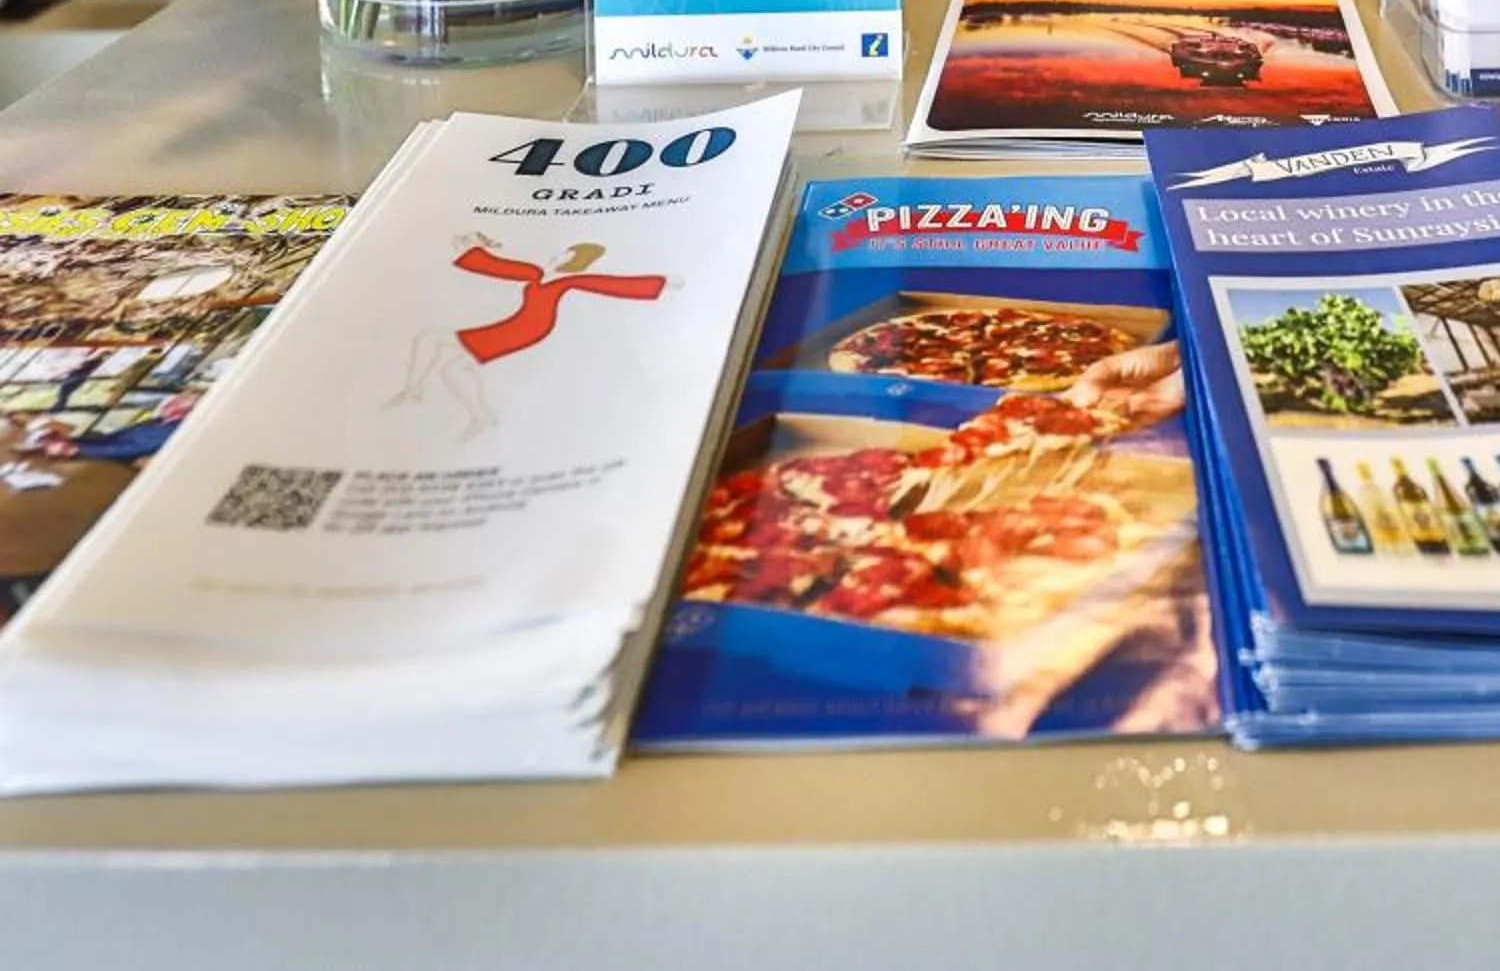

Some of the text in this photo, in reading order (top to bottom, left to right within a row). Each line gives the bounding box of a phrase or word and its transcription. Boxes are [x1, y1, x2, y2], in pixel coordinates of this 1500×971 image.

[609, 42, 718, 60] mildura
[488, 126, 737, 178] 400
[1275, 144, 1393, 176] VANDEN
[1353, 162, 1397, 175] Estate
[531, 182, 656, 201] GRADI
[473, 195, 692, 217] MILDURA TAKEAWAY MENU
[1196, 205, 1287, 226] Local
[1296, 201, 1410, 227] winery
[1421, 192, 1454, 212] in
[866, 204, 1112, 233] PIZZA'ING
[973, 236, 1036, 251] GREAT
[1206, 228, 1298, 247] heart
[1309, 225, 1348, 246] of
